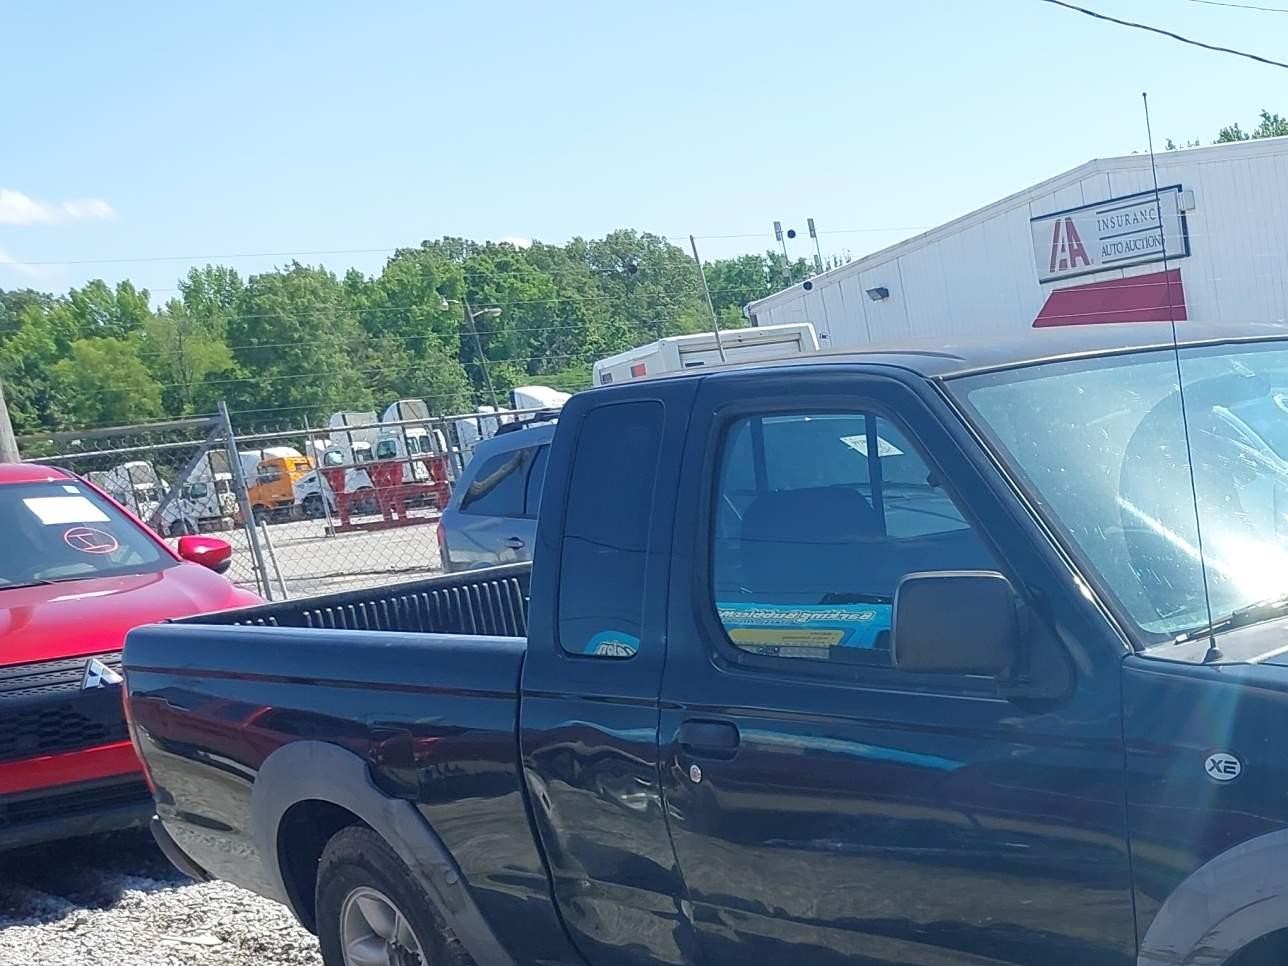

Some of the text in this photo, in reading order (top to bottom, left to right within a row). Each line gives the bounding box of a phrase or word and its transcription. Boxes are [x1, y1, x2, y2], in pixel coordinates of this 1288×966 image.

[1097, 208, 1162, 231] INSURANC
[1101, 242, 1124, 257] AUTO
[1208, 758, 1237, 775] XE
